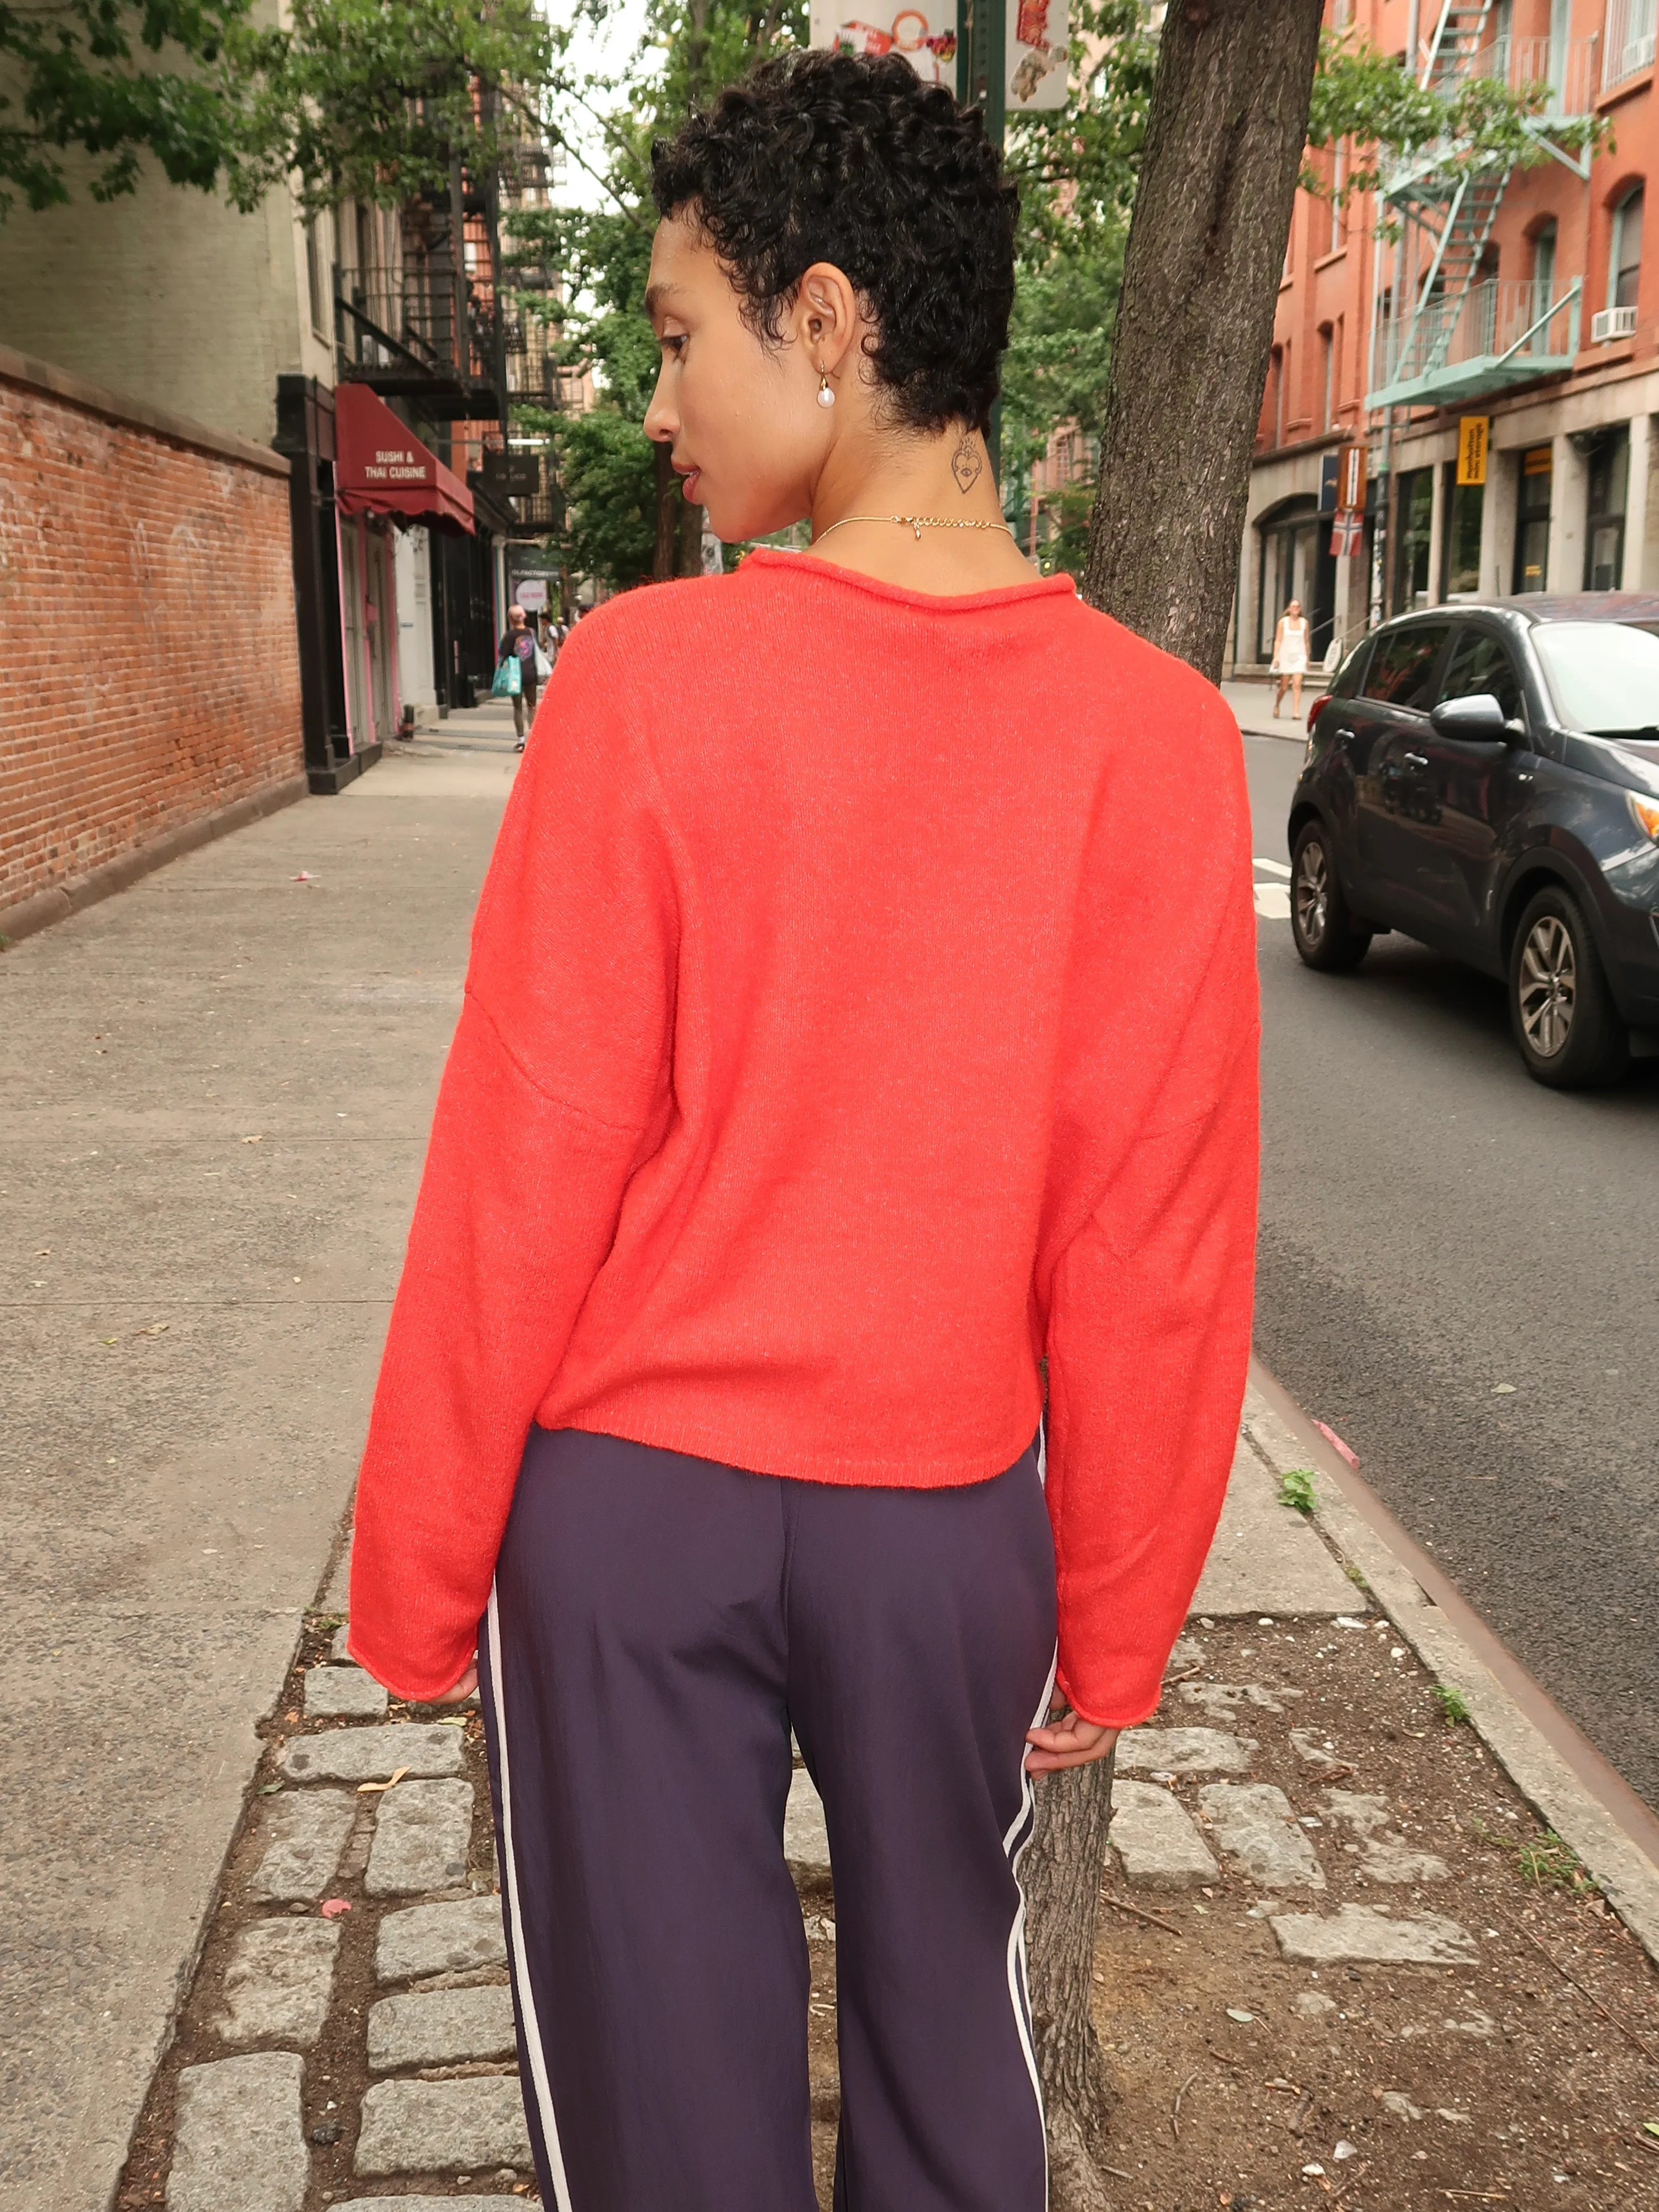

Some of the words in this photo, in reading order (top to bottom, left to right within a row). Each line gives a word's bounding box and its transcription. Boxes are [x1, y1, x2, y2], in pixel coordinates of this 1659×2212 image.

[376, 450, 403, 463] SUSHI
[406, 450, 413, 463] &
[365, 466, 386, 479] THAI
[389, 466, 426, 479] CUISINE
